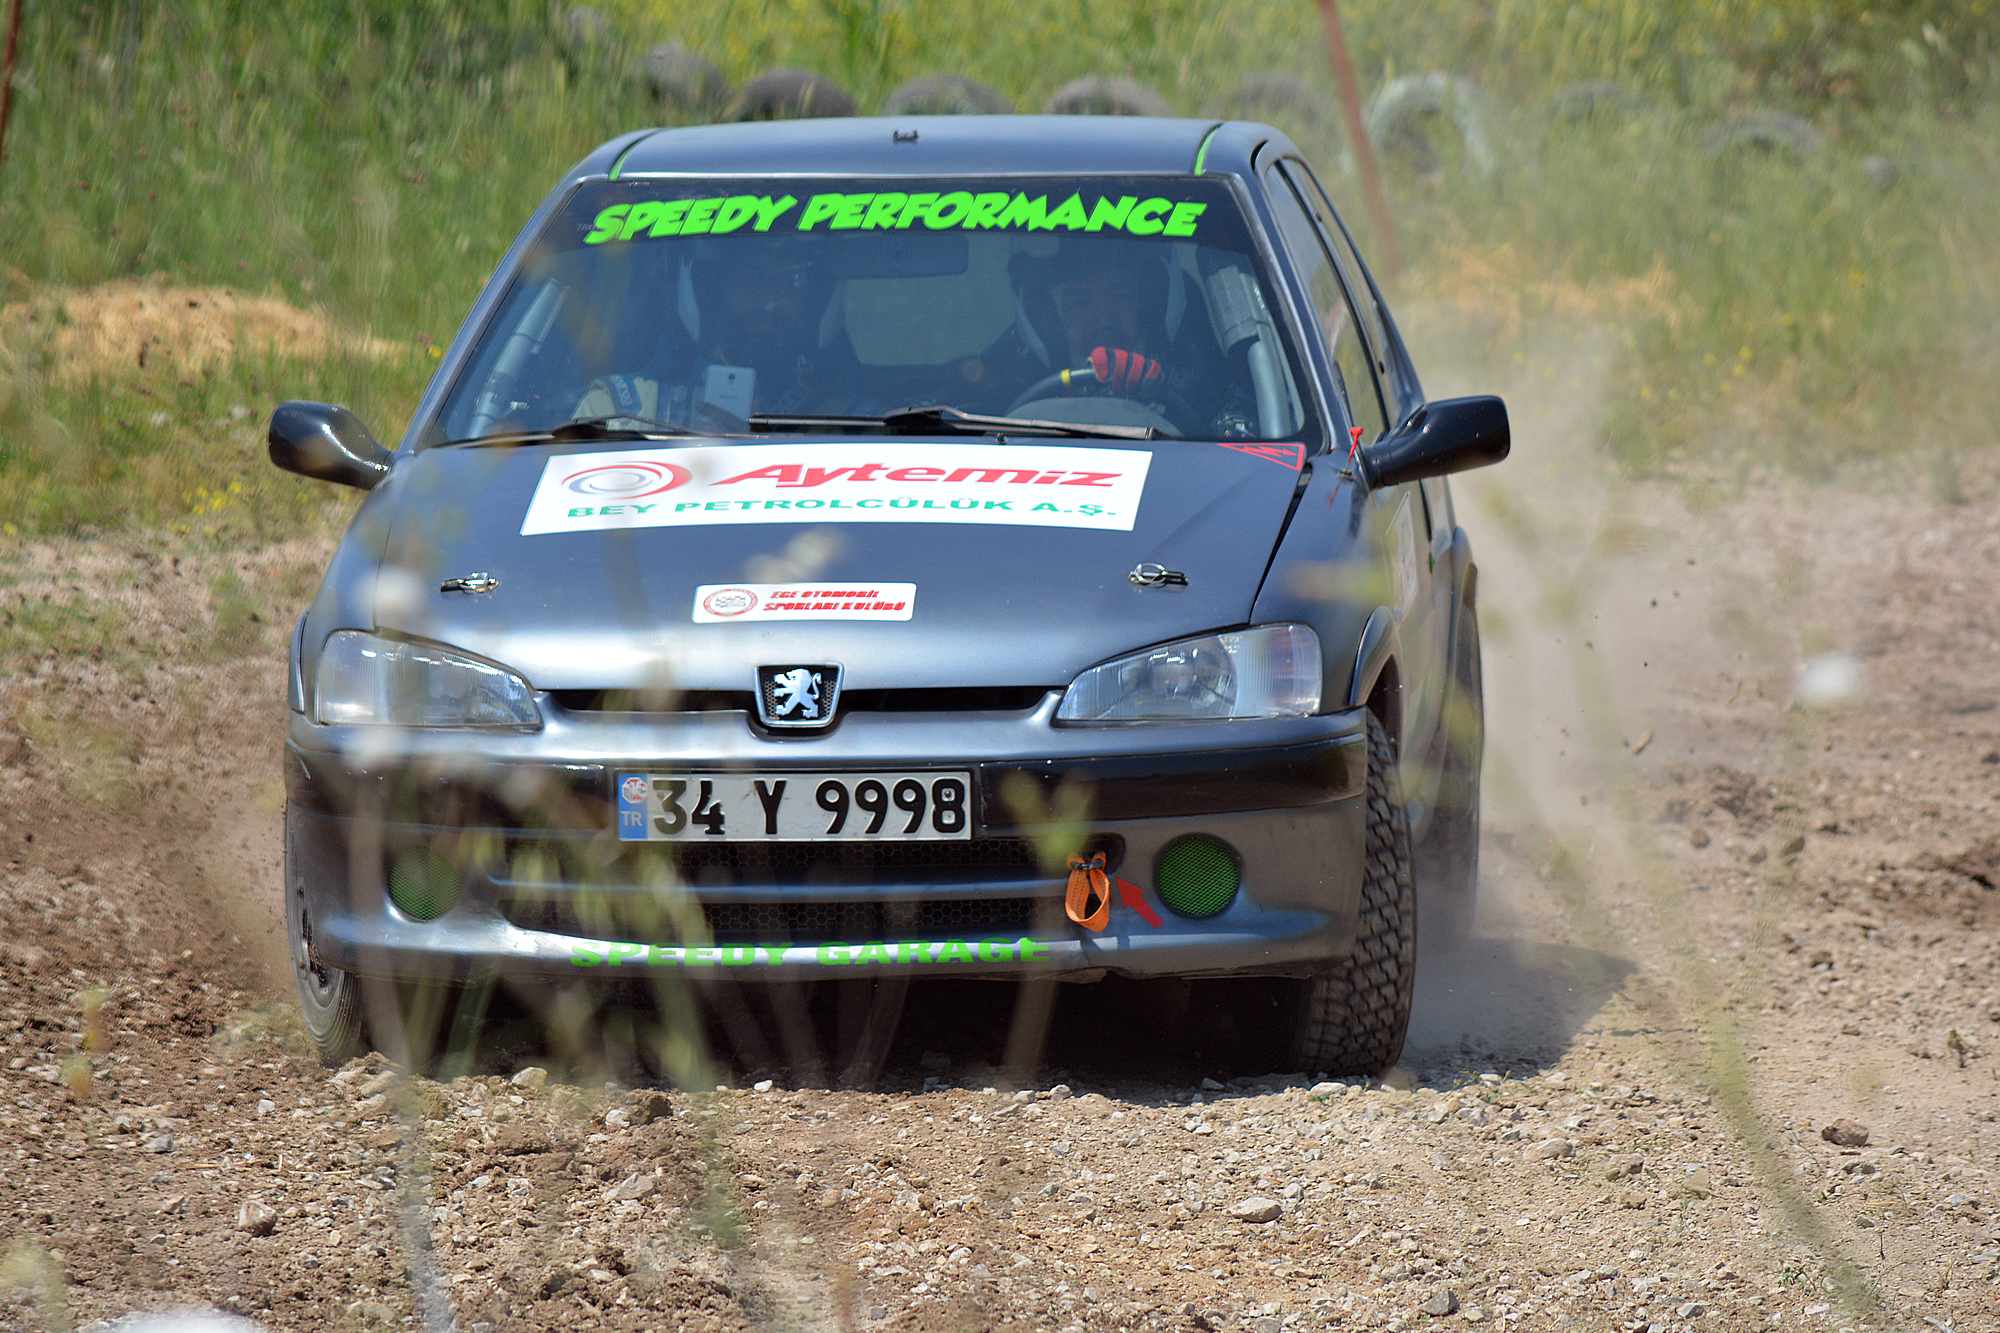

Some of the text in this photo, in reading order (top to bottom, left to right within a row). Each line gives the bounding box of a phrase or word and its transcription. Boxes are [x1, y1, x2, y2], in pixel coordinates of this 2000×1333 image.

[584, 191, 1208, 245] SPEEDY PERFORMANCE
[708, 463, 1122, 488] Aytemiz
[566, 497, 1117, 518] BEY PETROLCÜLÜK A.Ş.
[621, 811, 643, 827] TR
[653, 778, 966, 835] 34 Y 9998
[570, 937, 1050, 967] SPEEDY GARAGE
